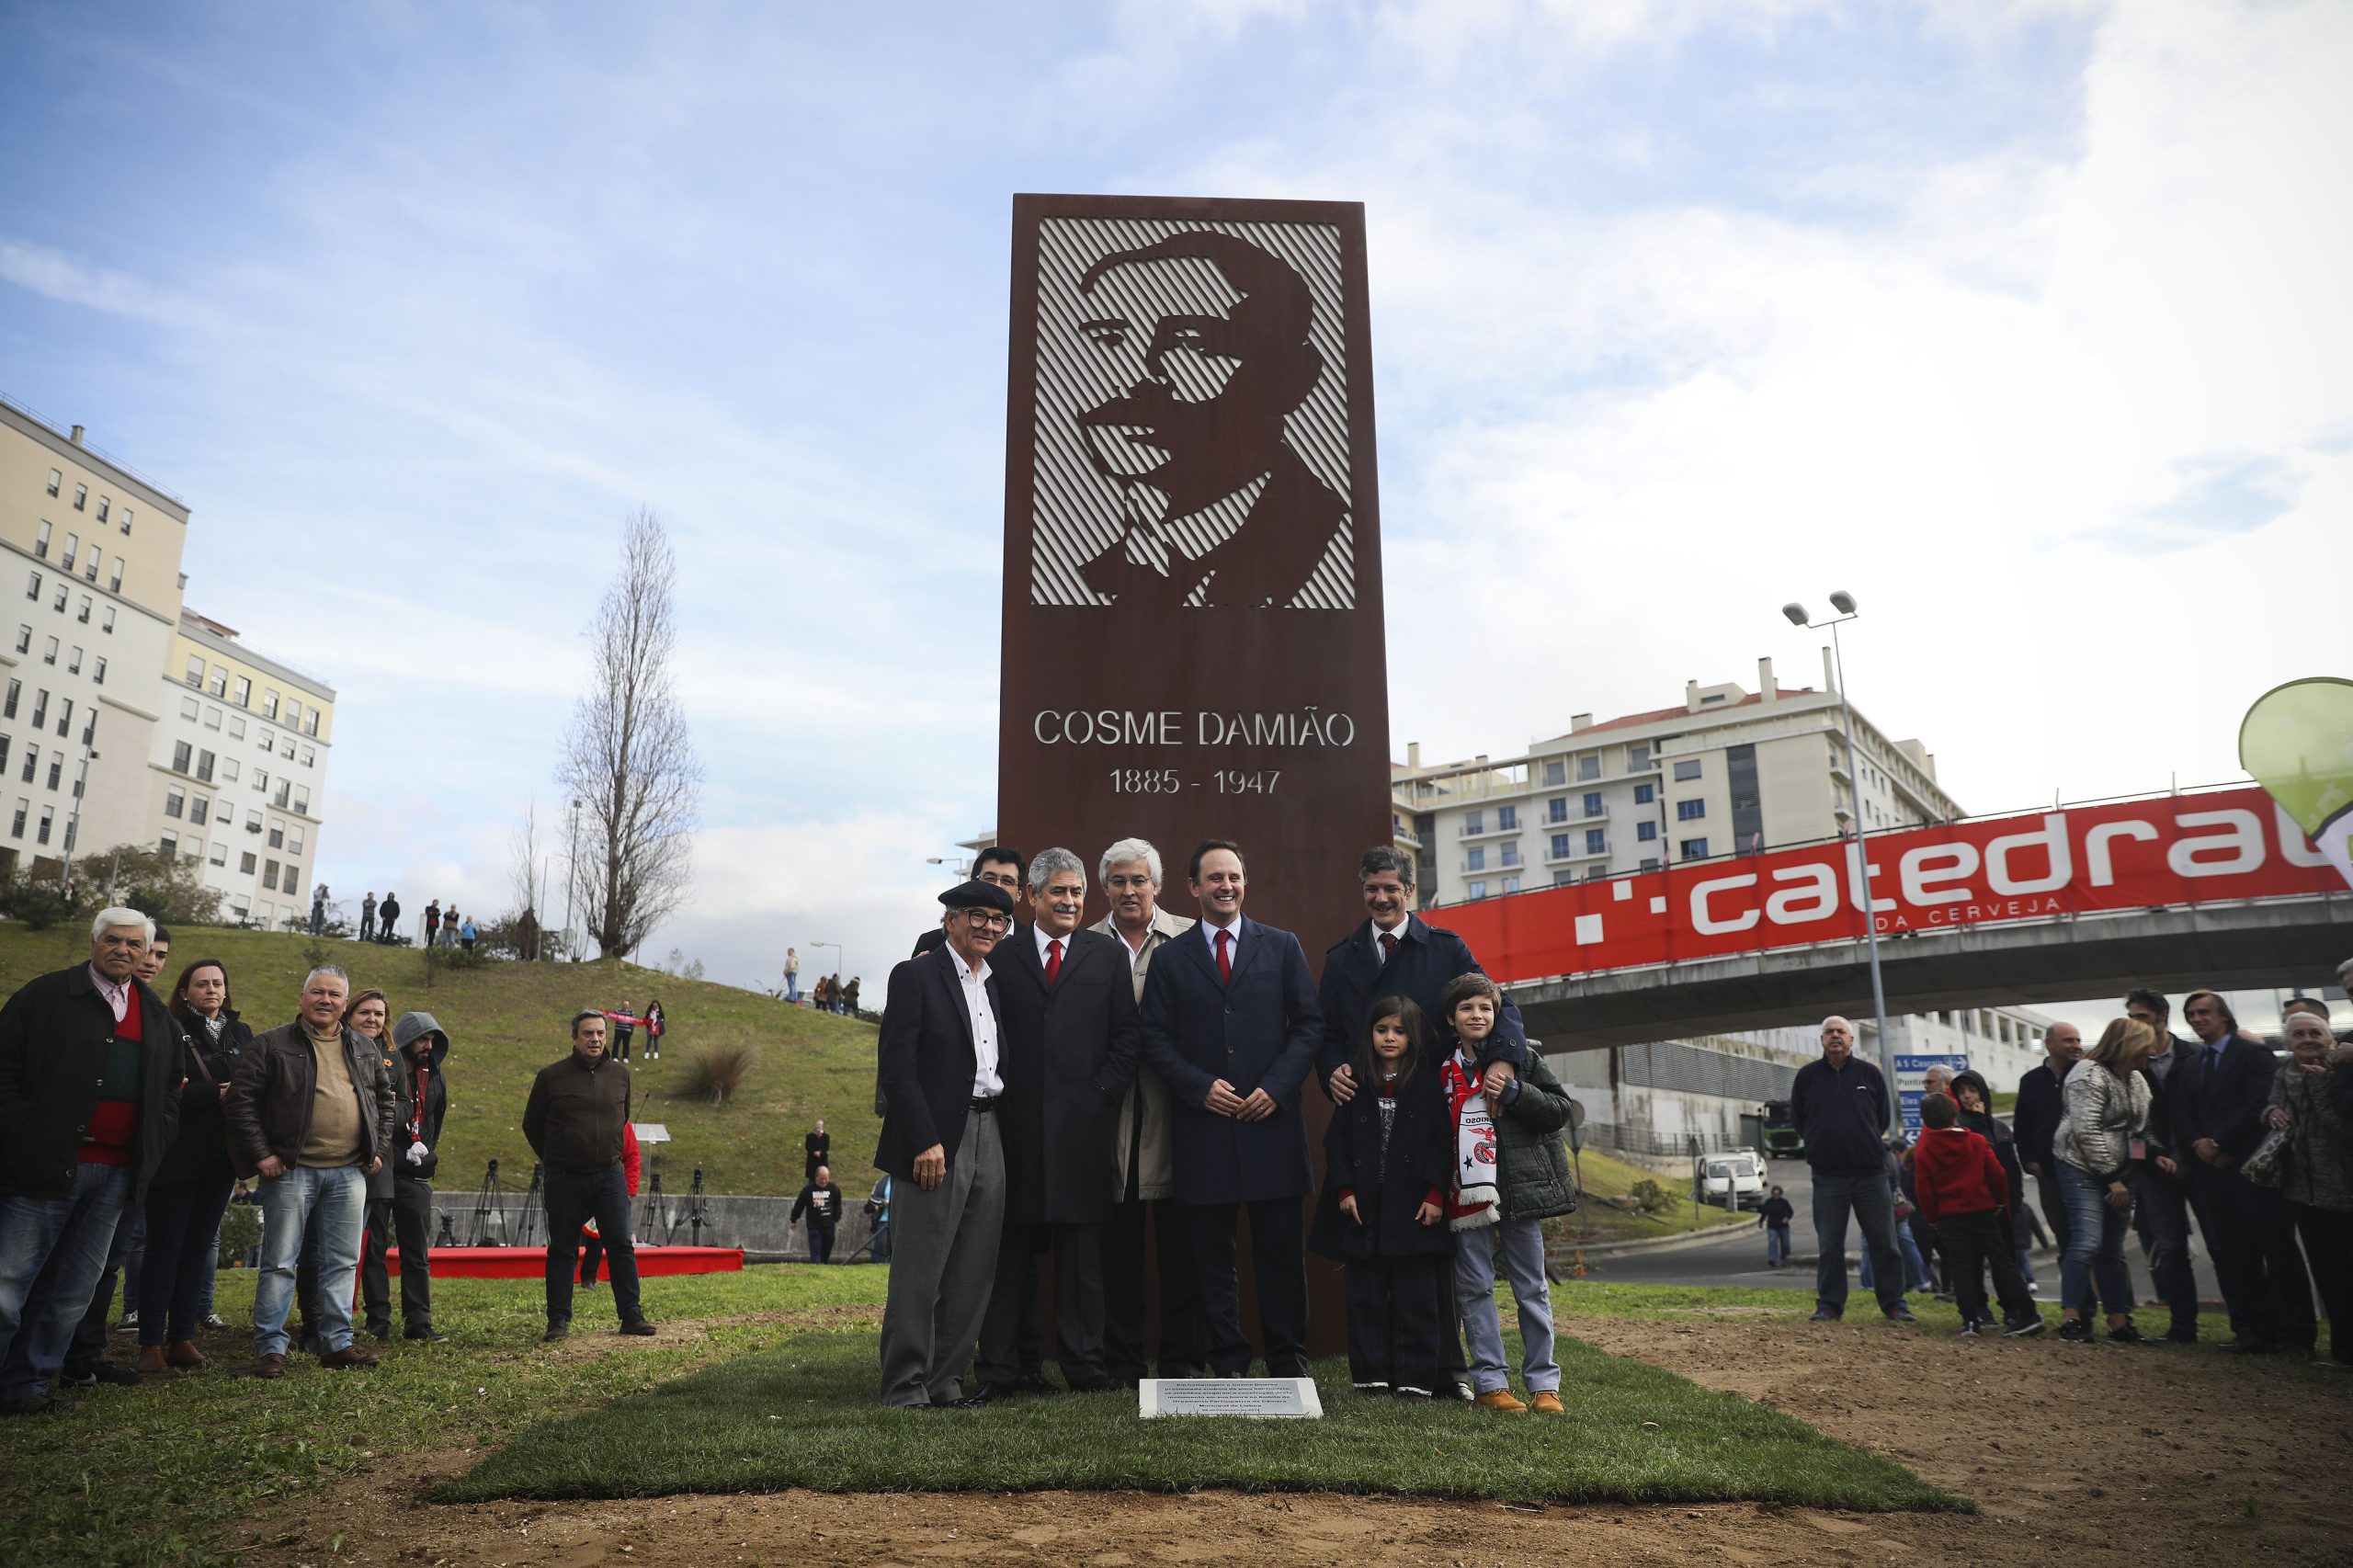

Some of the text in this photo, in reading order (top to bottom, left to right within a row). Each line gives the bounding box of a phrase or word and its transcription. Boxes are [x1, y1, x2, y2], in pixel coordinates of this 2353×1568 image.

[1034, 706, 1355, 746] COSME DAMIÃO
[1109, 768, 1180, 793] 1885
[1213, 769, 1281, 794] 1947
[1874, 897, 2060, 931] DA CERVEJA
